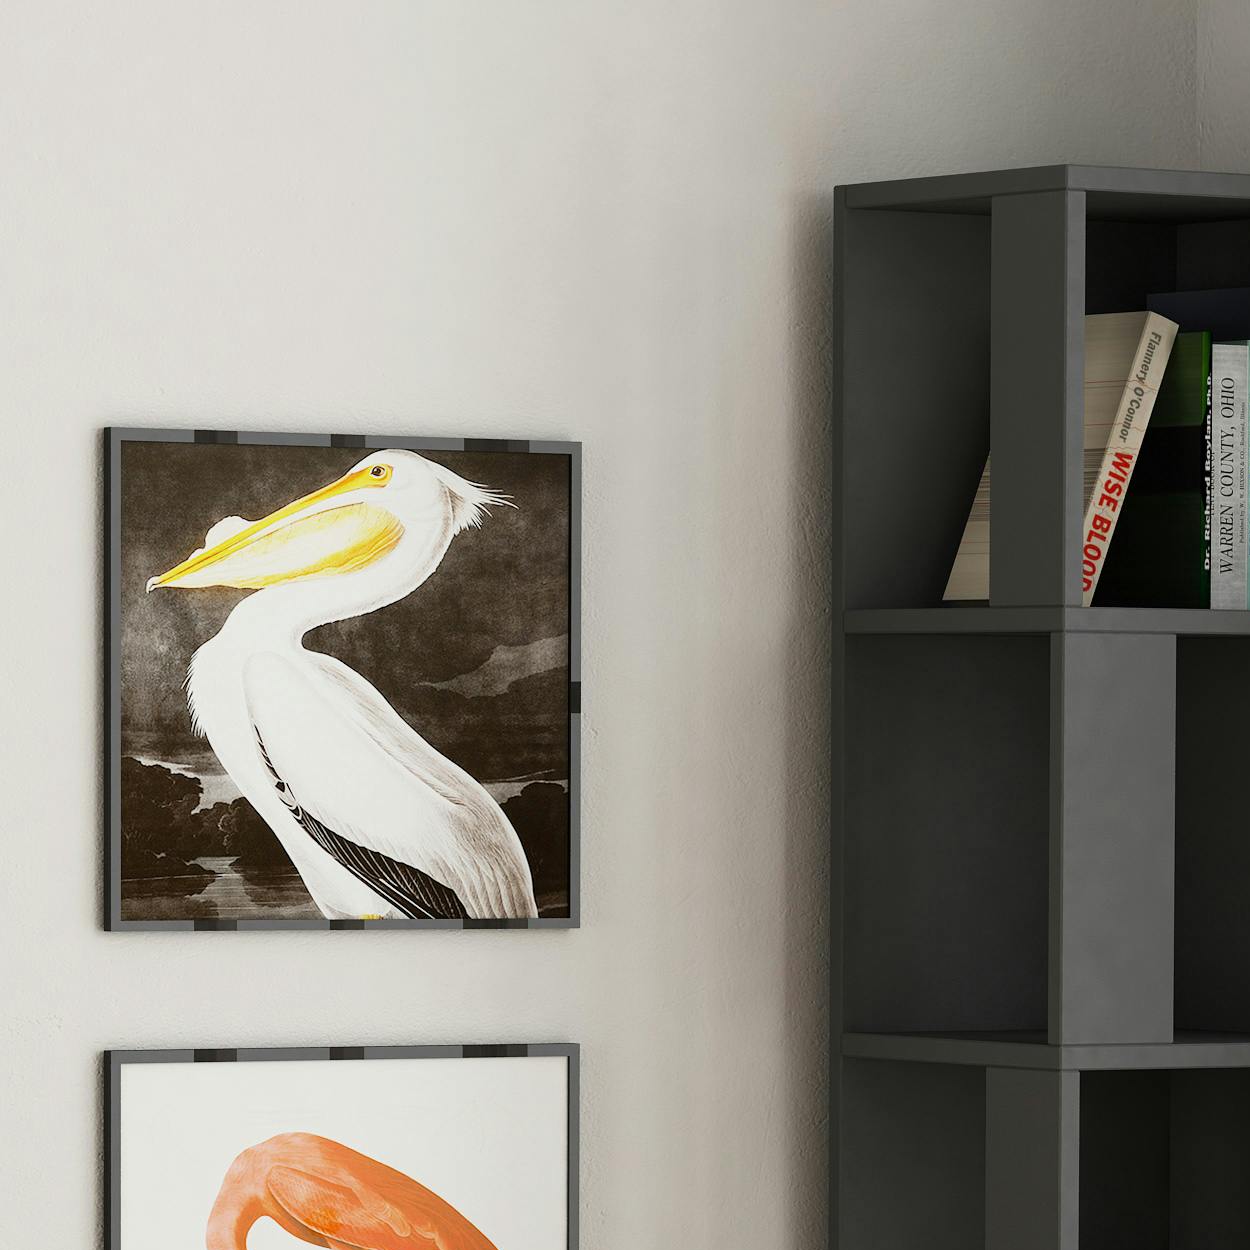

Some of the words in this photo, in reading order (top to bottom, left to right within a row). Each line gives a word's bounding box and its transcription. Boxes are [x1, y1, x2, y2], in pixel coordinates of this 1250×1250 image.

[1136, 331, 1161, 384] Flannery
[1119, 386, 1144, 443] O'Connor
[1220, 377, 1235, 419] OHIO
[1098, 452, 1133, 512] WISE
[1220, 426, 1236, 497] COUNTY,
[1220, 504, 1233, 574] WARREN
